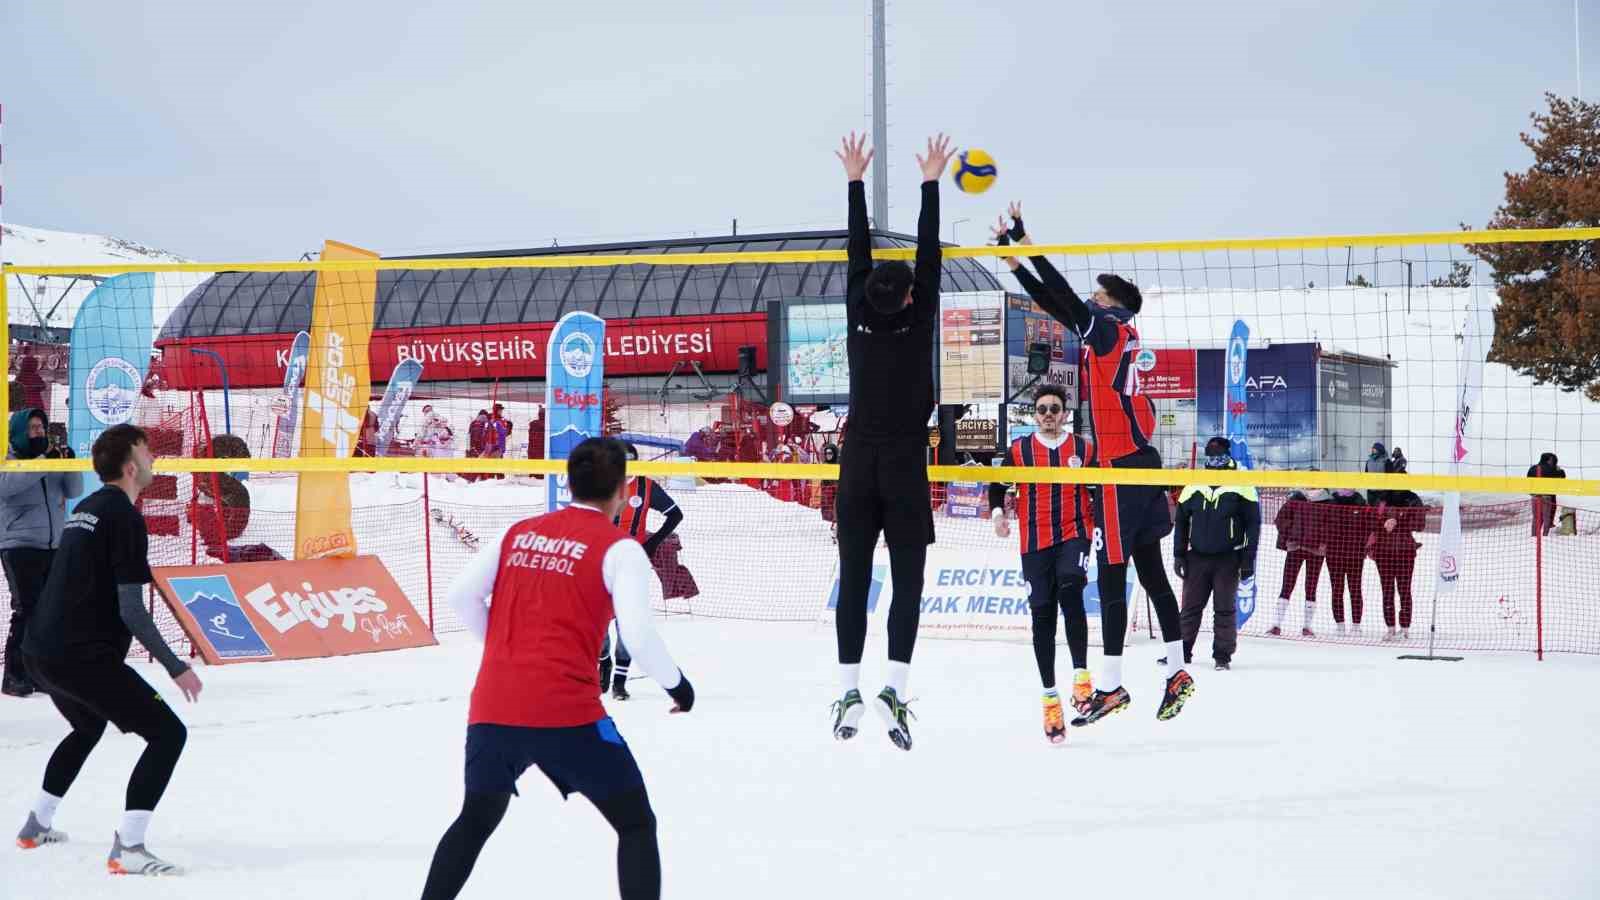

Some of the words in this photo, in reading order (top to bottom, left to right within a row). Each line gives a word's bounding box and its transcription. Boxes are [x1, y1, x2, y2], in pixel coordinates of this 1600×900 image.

[397, 336, 537, 366] BÜYÜKŞEHİR
[602, 327, 713, 356] LEDİYESİ
[511, 531, 588, 561] TÜRKİYE
[244, 582, 388, 634] Erciyes
[966, 596, 1031, 616] MERK
